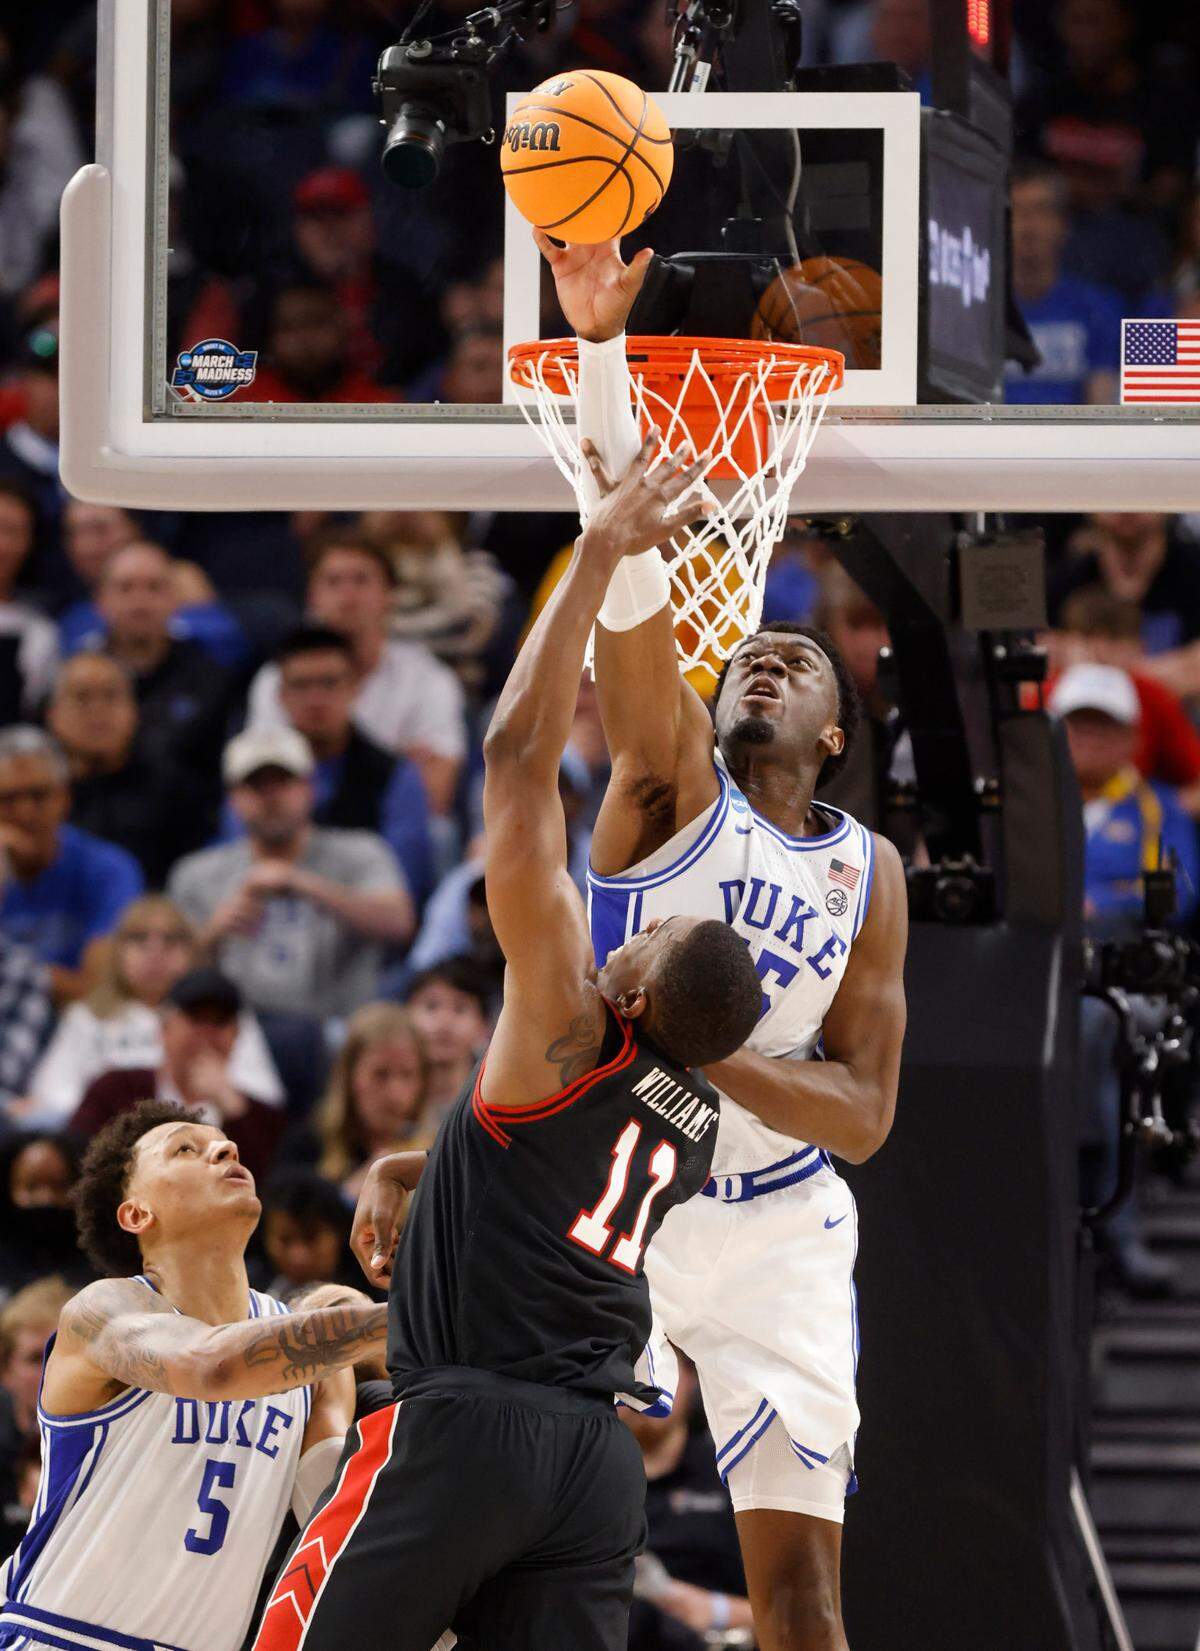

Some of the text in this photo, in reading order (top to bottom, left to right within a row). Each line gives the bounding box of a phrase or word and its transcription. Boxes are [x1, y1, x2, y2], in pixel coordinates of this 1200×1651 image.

[192, 355, 235, 368] MARCH
[196, 368, 254, 381] MADNESS
[719, 876, 848, 980] DUKE
[631, 1066, 719, 1143] WILLIAMS
[567, 1116, 678, 1275] 11
[171, 1397, 294, 1460] DUKE
[184, 1459, 236, 1556] 5
